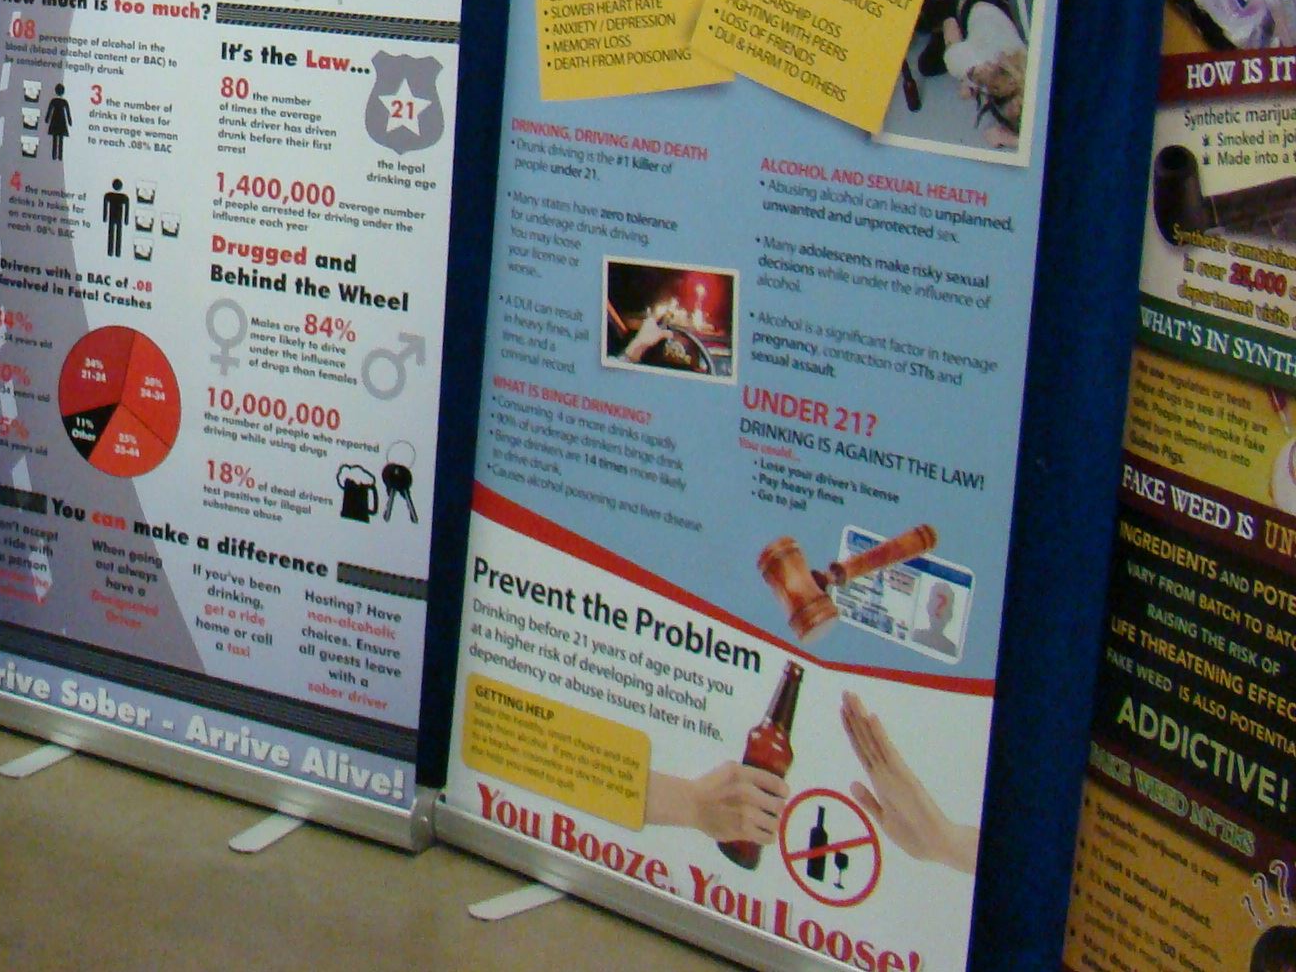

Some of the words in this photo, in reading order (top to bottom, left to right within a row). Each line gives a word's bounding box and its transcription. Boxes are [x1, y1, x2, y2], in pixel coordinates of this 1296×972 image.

[152, 1, 211, 21] much?
[221, 42, 253, 62] It's
[260, 45, 298, 68] the
[306, 50, 370, 74] Law...
[1187, 62, 1235, 89] HOW
[1242, 59, 1263, 84] IS
[90, 84, 102, 105] 3
[221, 77, 249, 98] 80
[391, 100, 414, 119] 21
[367, 174, 411, 189] drinking
[415, 180, 436, 190] age
[378, 160, 394, 170] the
[398, 162, 425, 174] legal
[217, 172, 335, 207] 1,400,000
[211, 235, 307, 266] Drugged
[315, 255, 357, 271] and
[211, 264, 287, 293] Behind
[295, 276, 331, 298] the
[338, 281, 409, 312] Wheel
[304, 314, 356, 342] 84%
[207, 387, 341, 430] 10,000,000
[742, 385, 828, 426] UNDER
[834, 407, 877, 437] 21?
[740, 418, 815, 449] DRINKING
[818, 437, 831, 454] IS
[835, 443, 904, 470] AGAINST
[907, 457, 937, 479] THE
[942, 468, 985, 491] LAW!
[207, 459, 255, 489] 18%
[1122, 464, 1166, 509] FAKE
[1170, 483, 1230, 532] WEED
[1236, 511, 1254, 541] IS
[51, 498, 86, 521] You
[91, 511, 126, 530] can
[133, 520, 189, 546] make
[197, 535, 209, 549] a
[217, 538, 328, 577] difference
[474, 556, 575, 614] Prevent
[583, 593, 628, 630] the
[636, 608, 762, 673] Problem
[61, 681, 151, 728] Sober
[185, 717, 290, 768] Arrive
[303, 746, 404, 799] Alive!
[1117, 697, 1289, 813] ADDICTIVE!
[476, 781, 541, 840] You
[688, 865, 762, 929] You
[773, 900, 921, 972] Loose!
